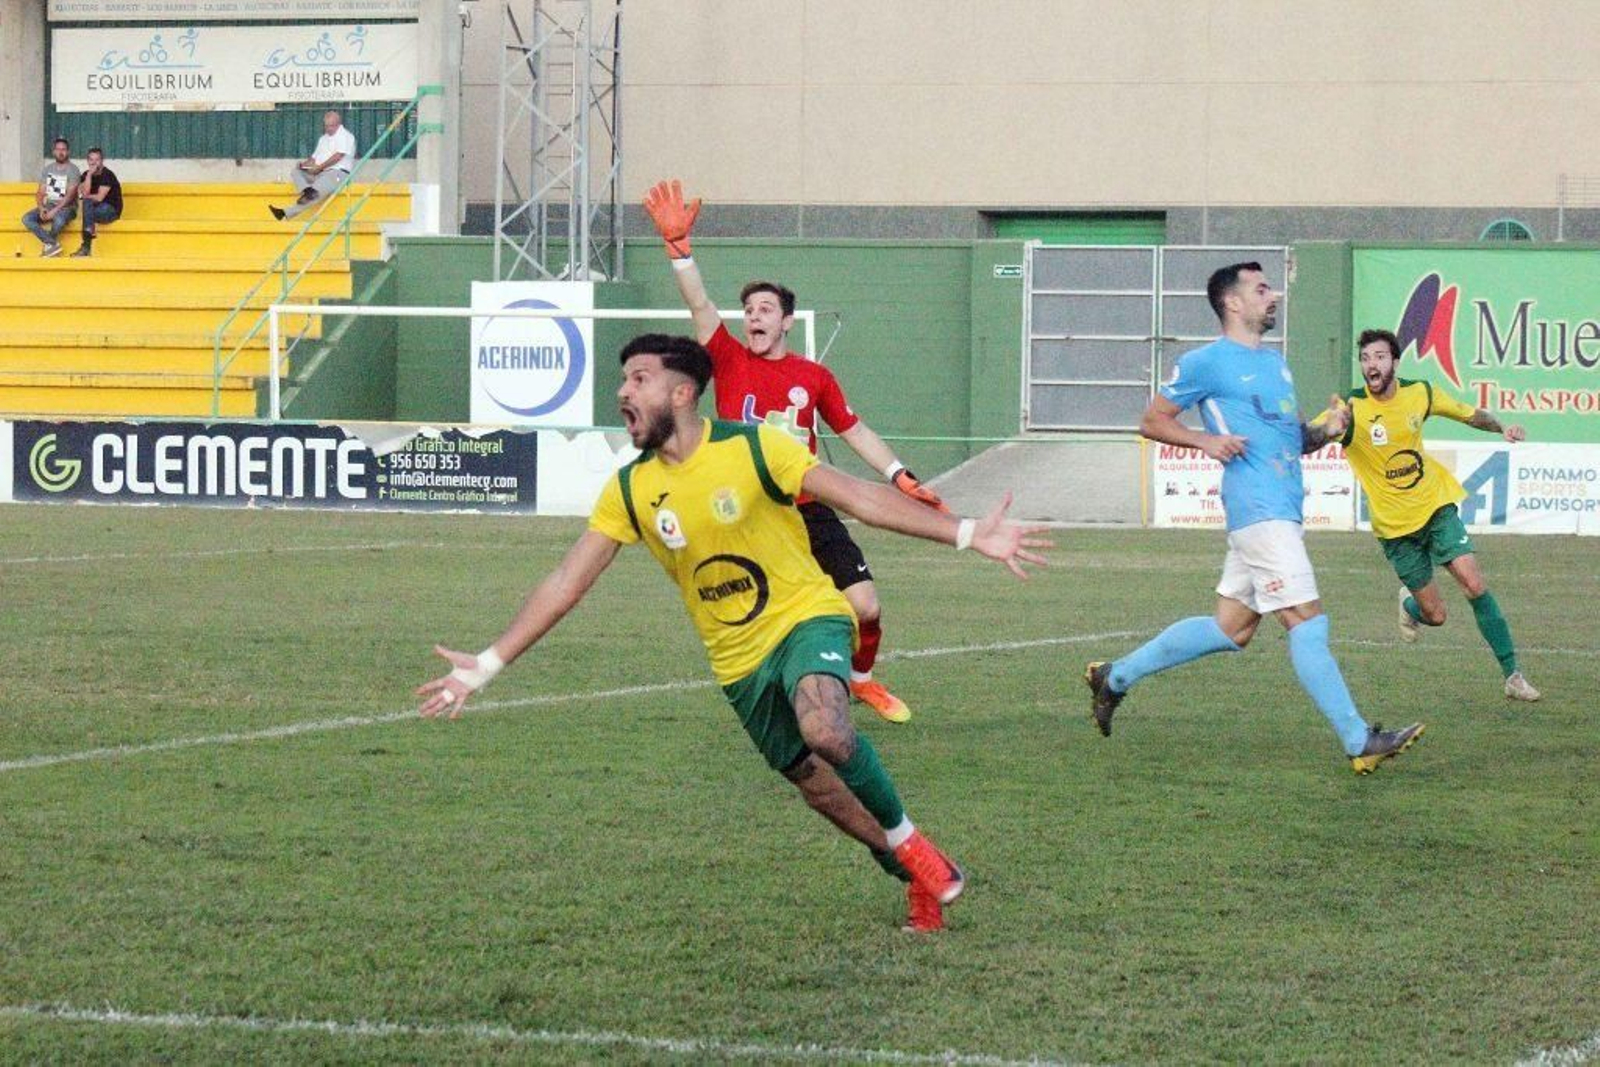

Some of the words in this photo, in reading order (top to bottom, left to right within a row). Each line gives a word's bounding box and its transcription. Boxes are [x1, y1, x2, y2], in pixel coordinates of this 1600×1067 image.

[87, 74, 212, 90] EQUILIBRIUM
[254, 71, 381, 88] EQUILIBRIUM
[478, 346, 565, 370] ACERINOX
[1472, 382, 1600, 411] TRASPO
[459, 438, 504, 457] Integral
[91, 433, 368, 499] CLEMENTE
[390, 453, 412, 469] 956
[414, 453, 437, 469] 650
[440, 454, 462, 470] 353
[1159, 463, 1199, 471] ALQUILER
[1201, 463, 1212, 471] DE
[389, 471, 518, 491] info@clementecg.com
[1518, 468, 1598, 482] DYNAMO
[1517, 481, 1587, 496] SPORTS
